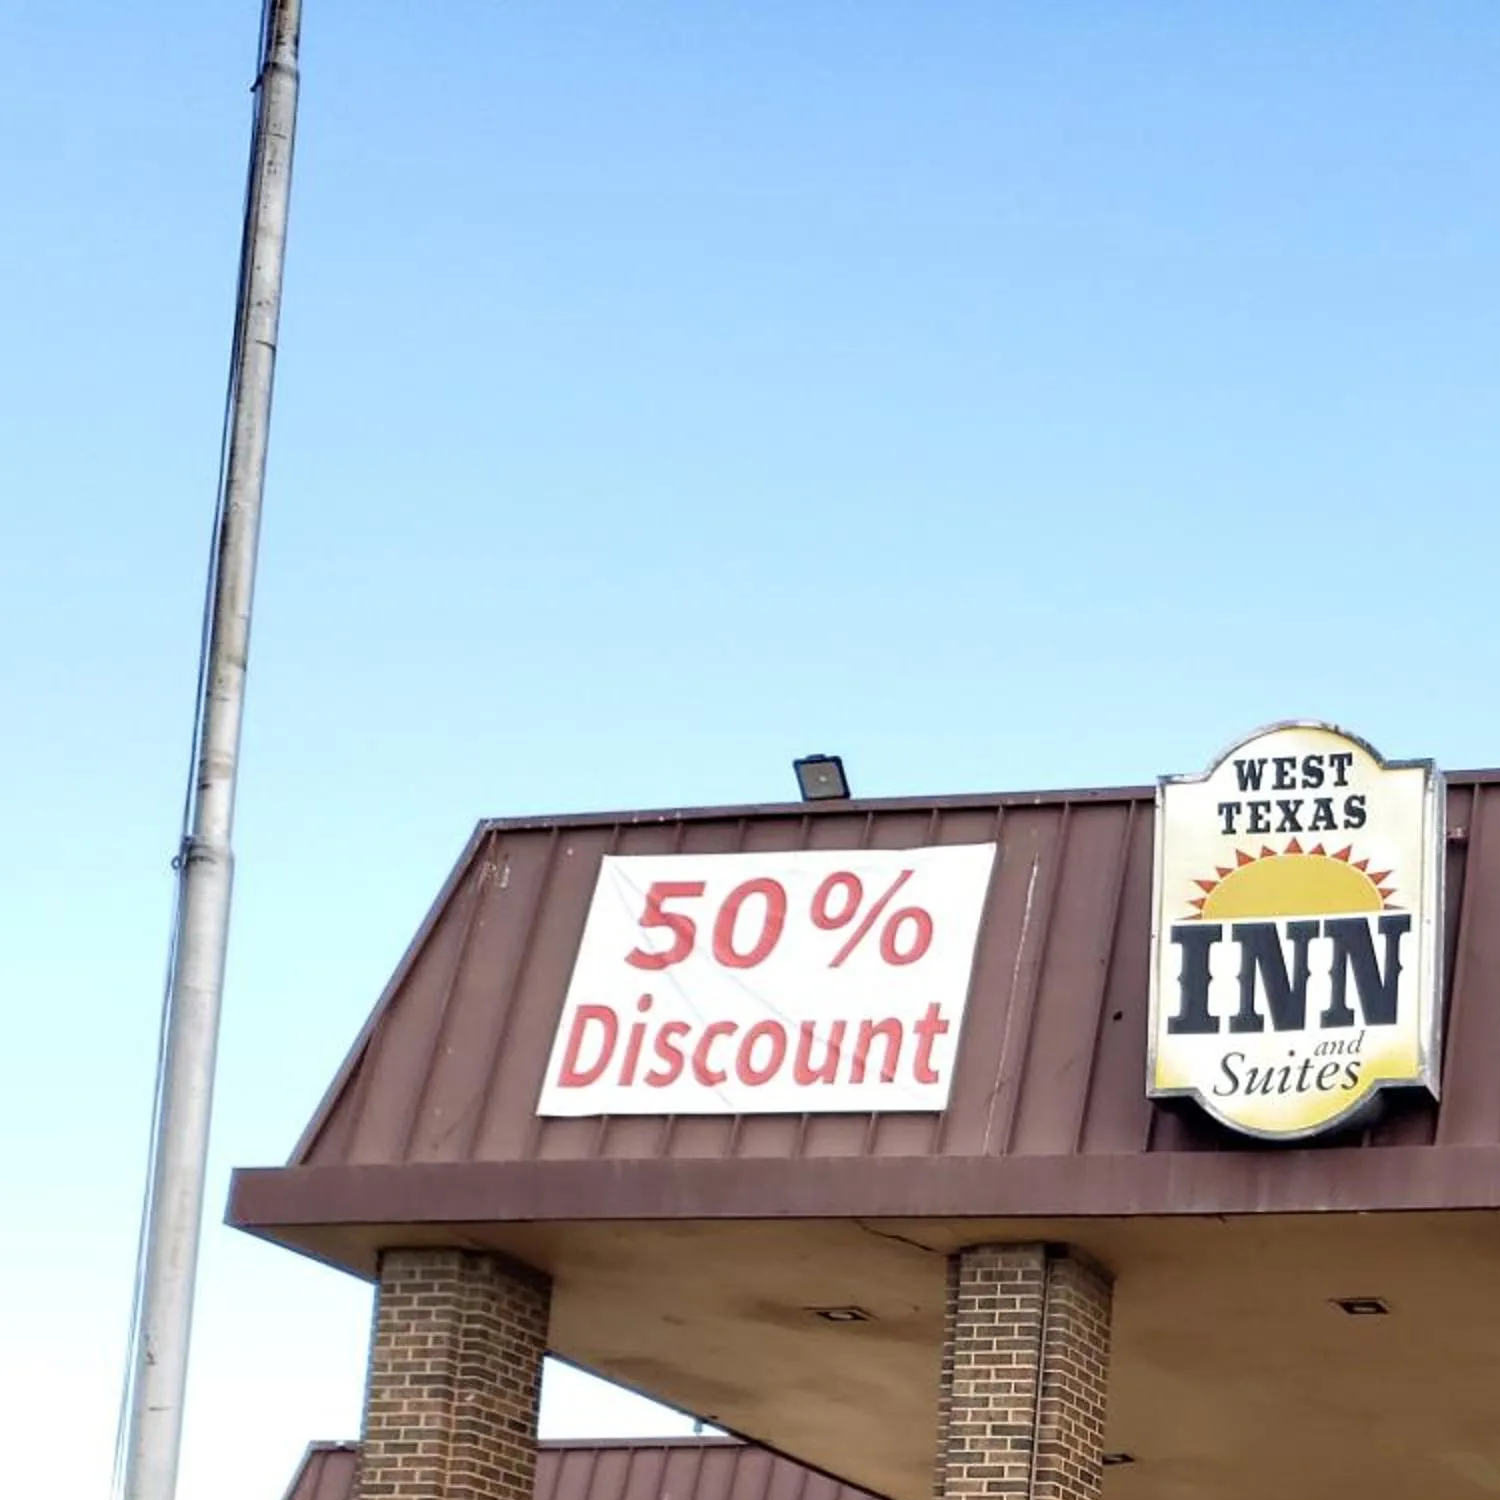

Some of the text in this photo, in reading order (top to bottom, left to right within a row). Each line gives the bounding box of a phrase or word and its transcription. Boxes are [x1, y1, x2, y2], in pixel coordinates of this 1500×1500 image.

[1233, 752, 1354, 793] WEST
[1217, 794, 1368, 836] TEXAS
[1167, 913, 1412, 1035] INN
[557, 993, 950, 1089] Discount
[1313, 1030, 1366, 1056] and
[1212, 1048, 1362, 1097] Suites
